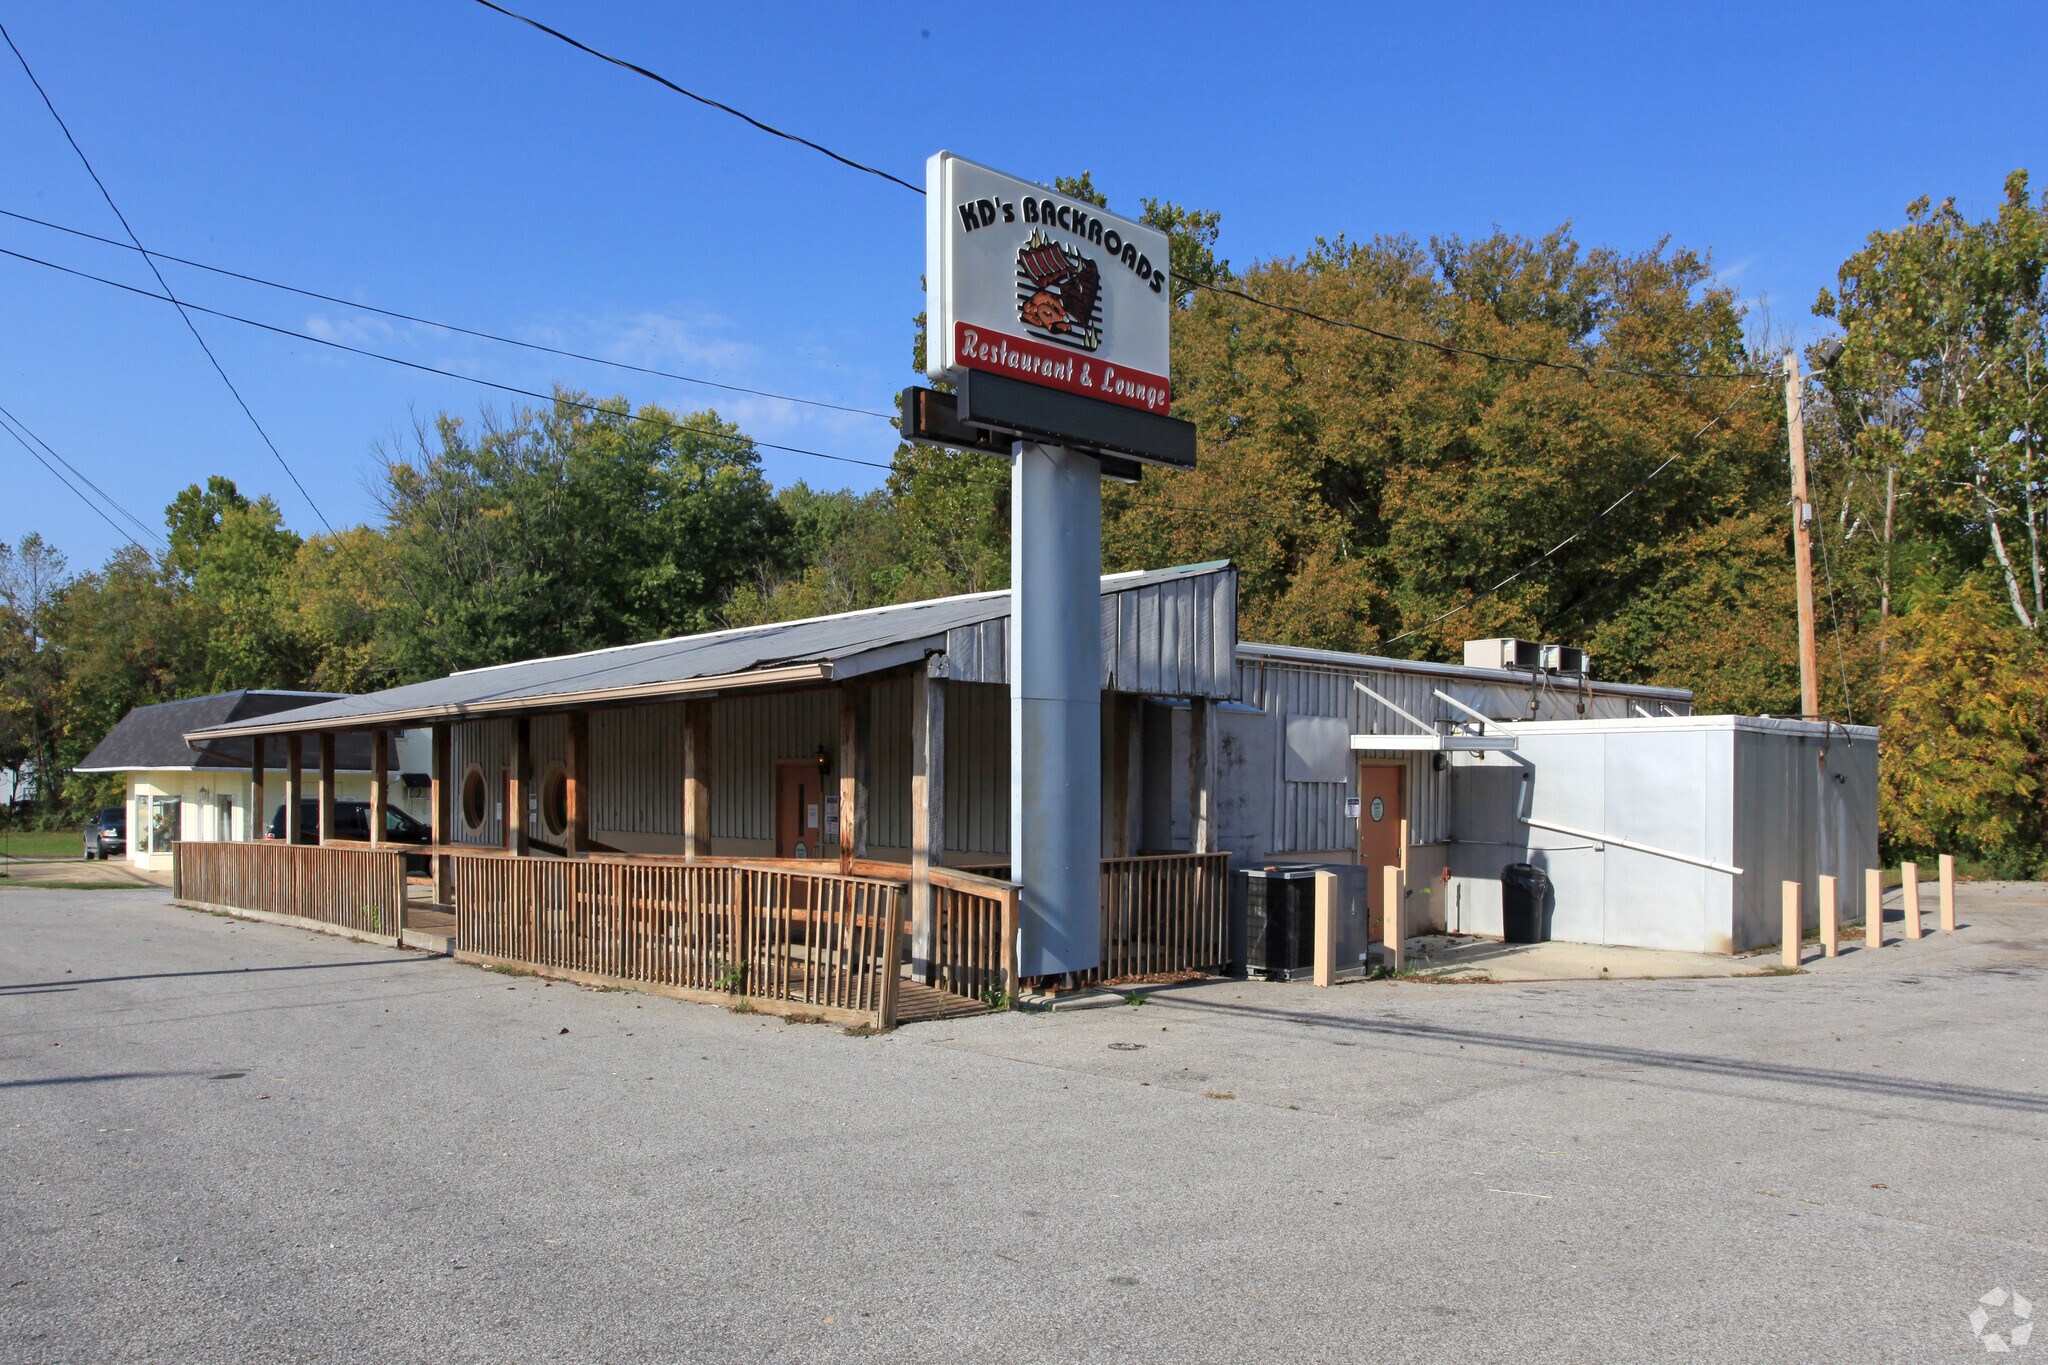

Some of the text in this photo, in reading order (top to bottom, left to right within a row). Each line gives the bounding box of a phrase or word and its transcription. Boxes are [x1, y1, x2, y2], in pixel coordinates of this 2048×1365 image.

[958, 196, 1166, 293] KD's BACKROADS
[962, 329, 1165, 408] Restaurant & Lounge
